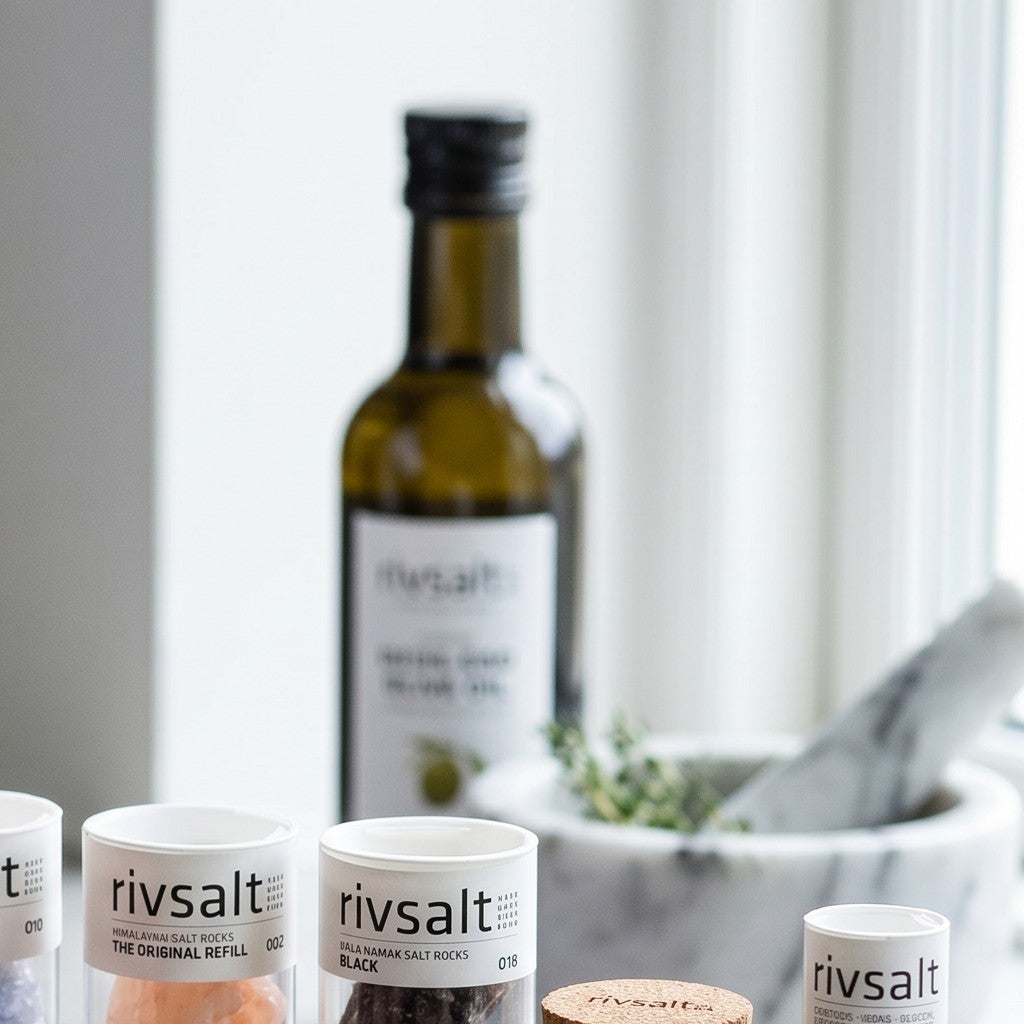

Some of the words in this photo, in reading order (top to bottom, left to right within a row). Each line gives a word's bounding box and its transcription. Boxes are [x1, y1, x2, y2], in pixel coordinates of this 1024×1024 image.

[112, 869, 263, 918] rivsalt
[340, 883, 492, 935] rivsalt
[25, 918, 43, 934] 010
[171, 933, 198, 943] SALT
[201, 932, 234, 943] ROCKS
[266, 934, 284, 951] 002
[112, 940, 134, 955] THE
[137, 943, 201, 959] ORIGINAL
[205, 943, 248, 959] REFILL
[364, 946, 401, 960] NAMAK
[404, 950, 431, 960] SALT
[434, 949, 469, 960] ROCKS
[340, 954, 378, 973] BLACK
[498, 954, 517, 970] 018
[814, 954, 939, 1001] rivsalt
